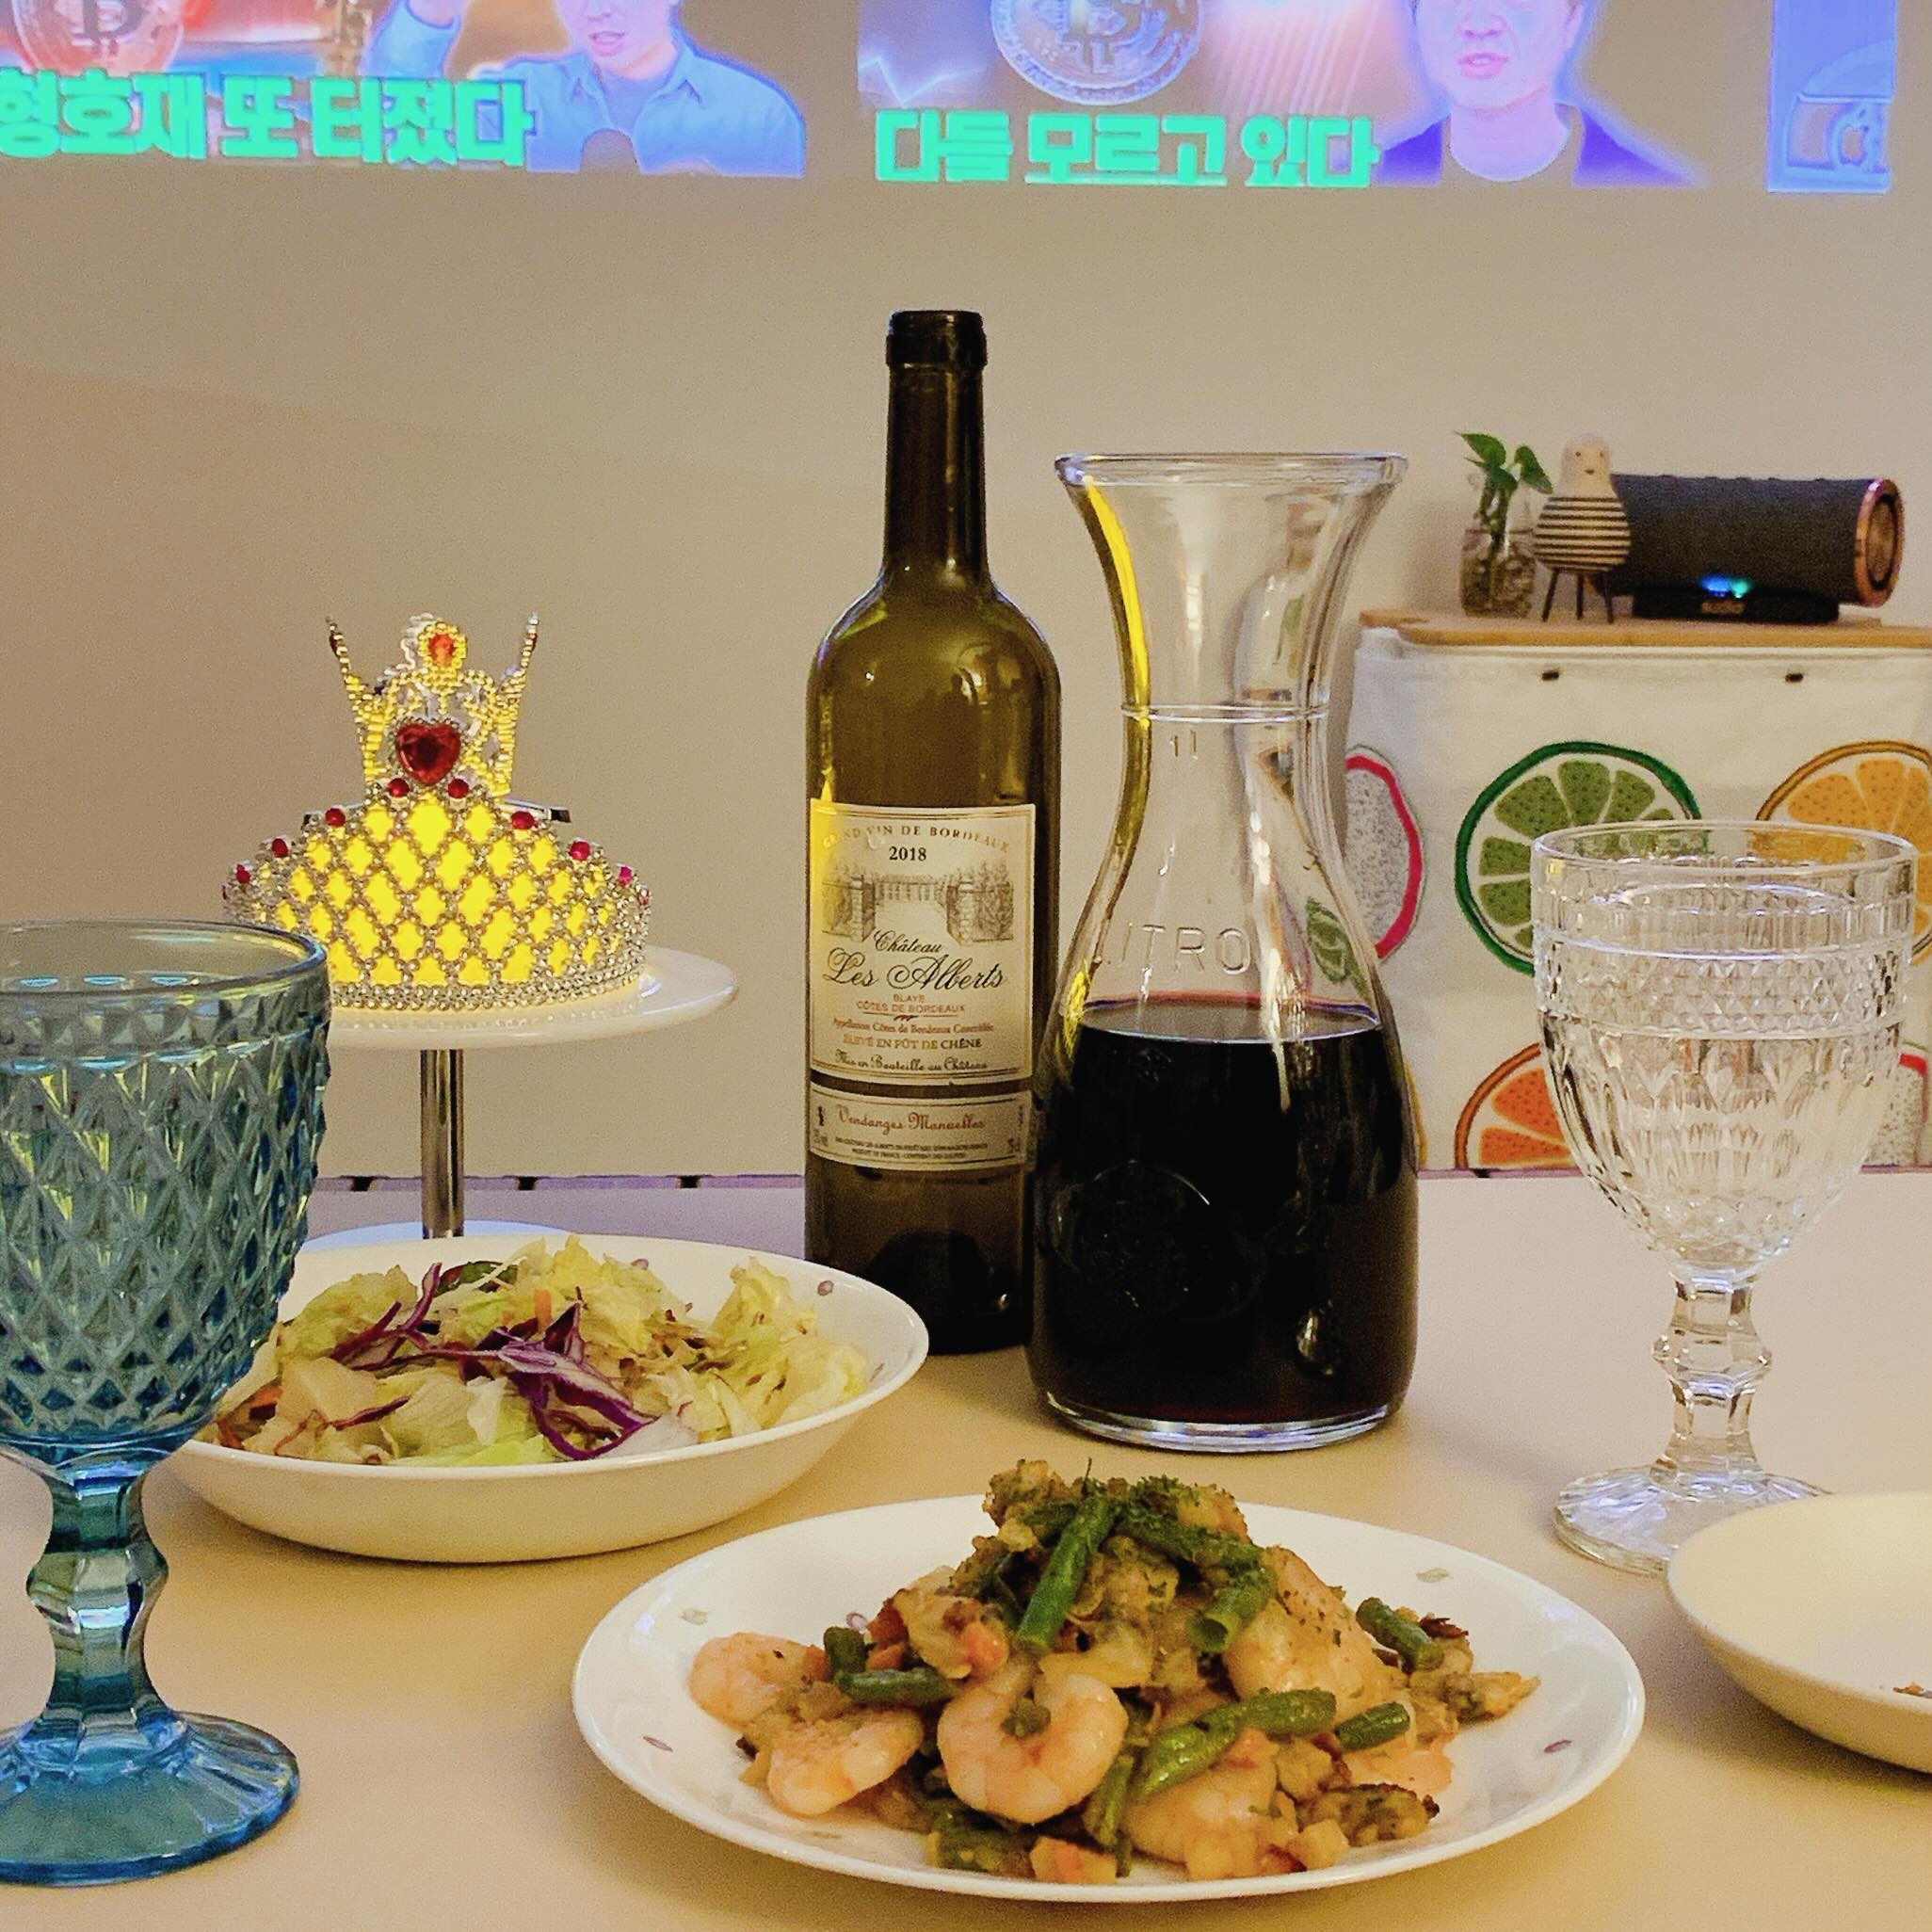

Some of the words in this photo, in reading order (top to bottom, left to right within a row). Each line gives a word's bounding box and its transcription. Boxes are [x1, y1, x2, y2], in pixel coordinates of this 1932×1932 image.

[219, 75, 298, 158] 또
[312, 76, 538, 166] 터졌다
[875, 109, 1014, 183] 다들
[1024, 112, 1228, 185] 모르고
[1240, 114, 1382, 188] 있다
[901, 826, 921, 835] DE
[889, 845, 927, 861] 2018
[874, 929, 943, 954] Château
[822, 947, 879, 988] Les
[887, 954, 1008, 990] Alberts
[922, 1039, 938, 1050] DE
